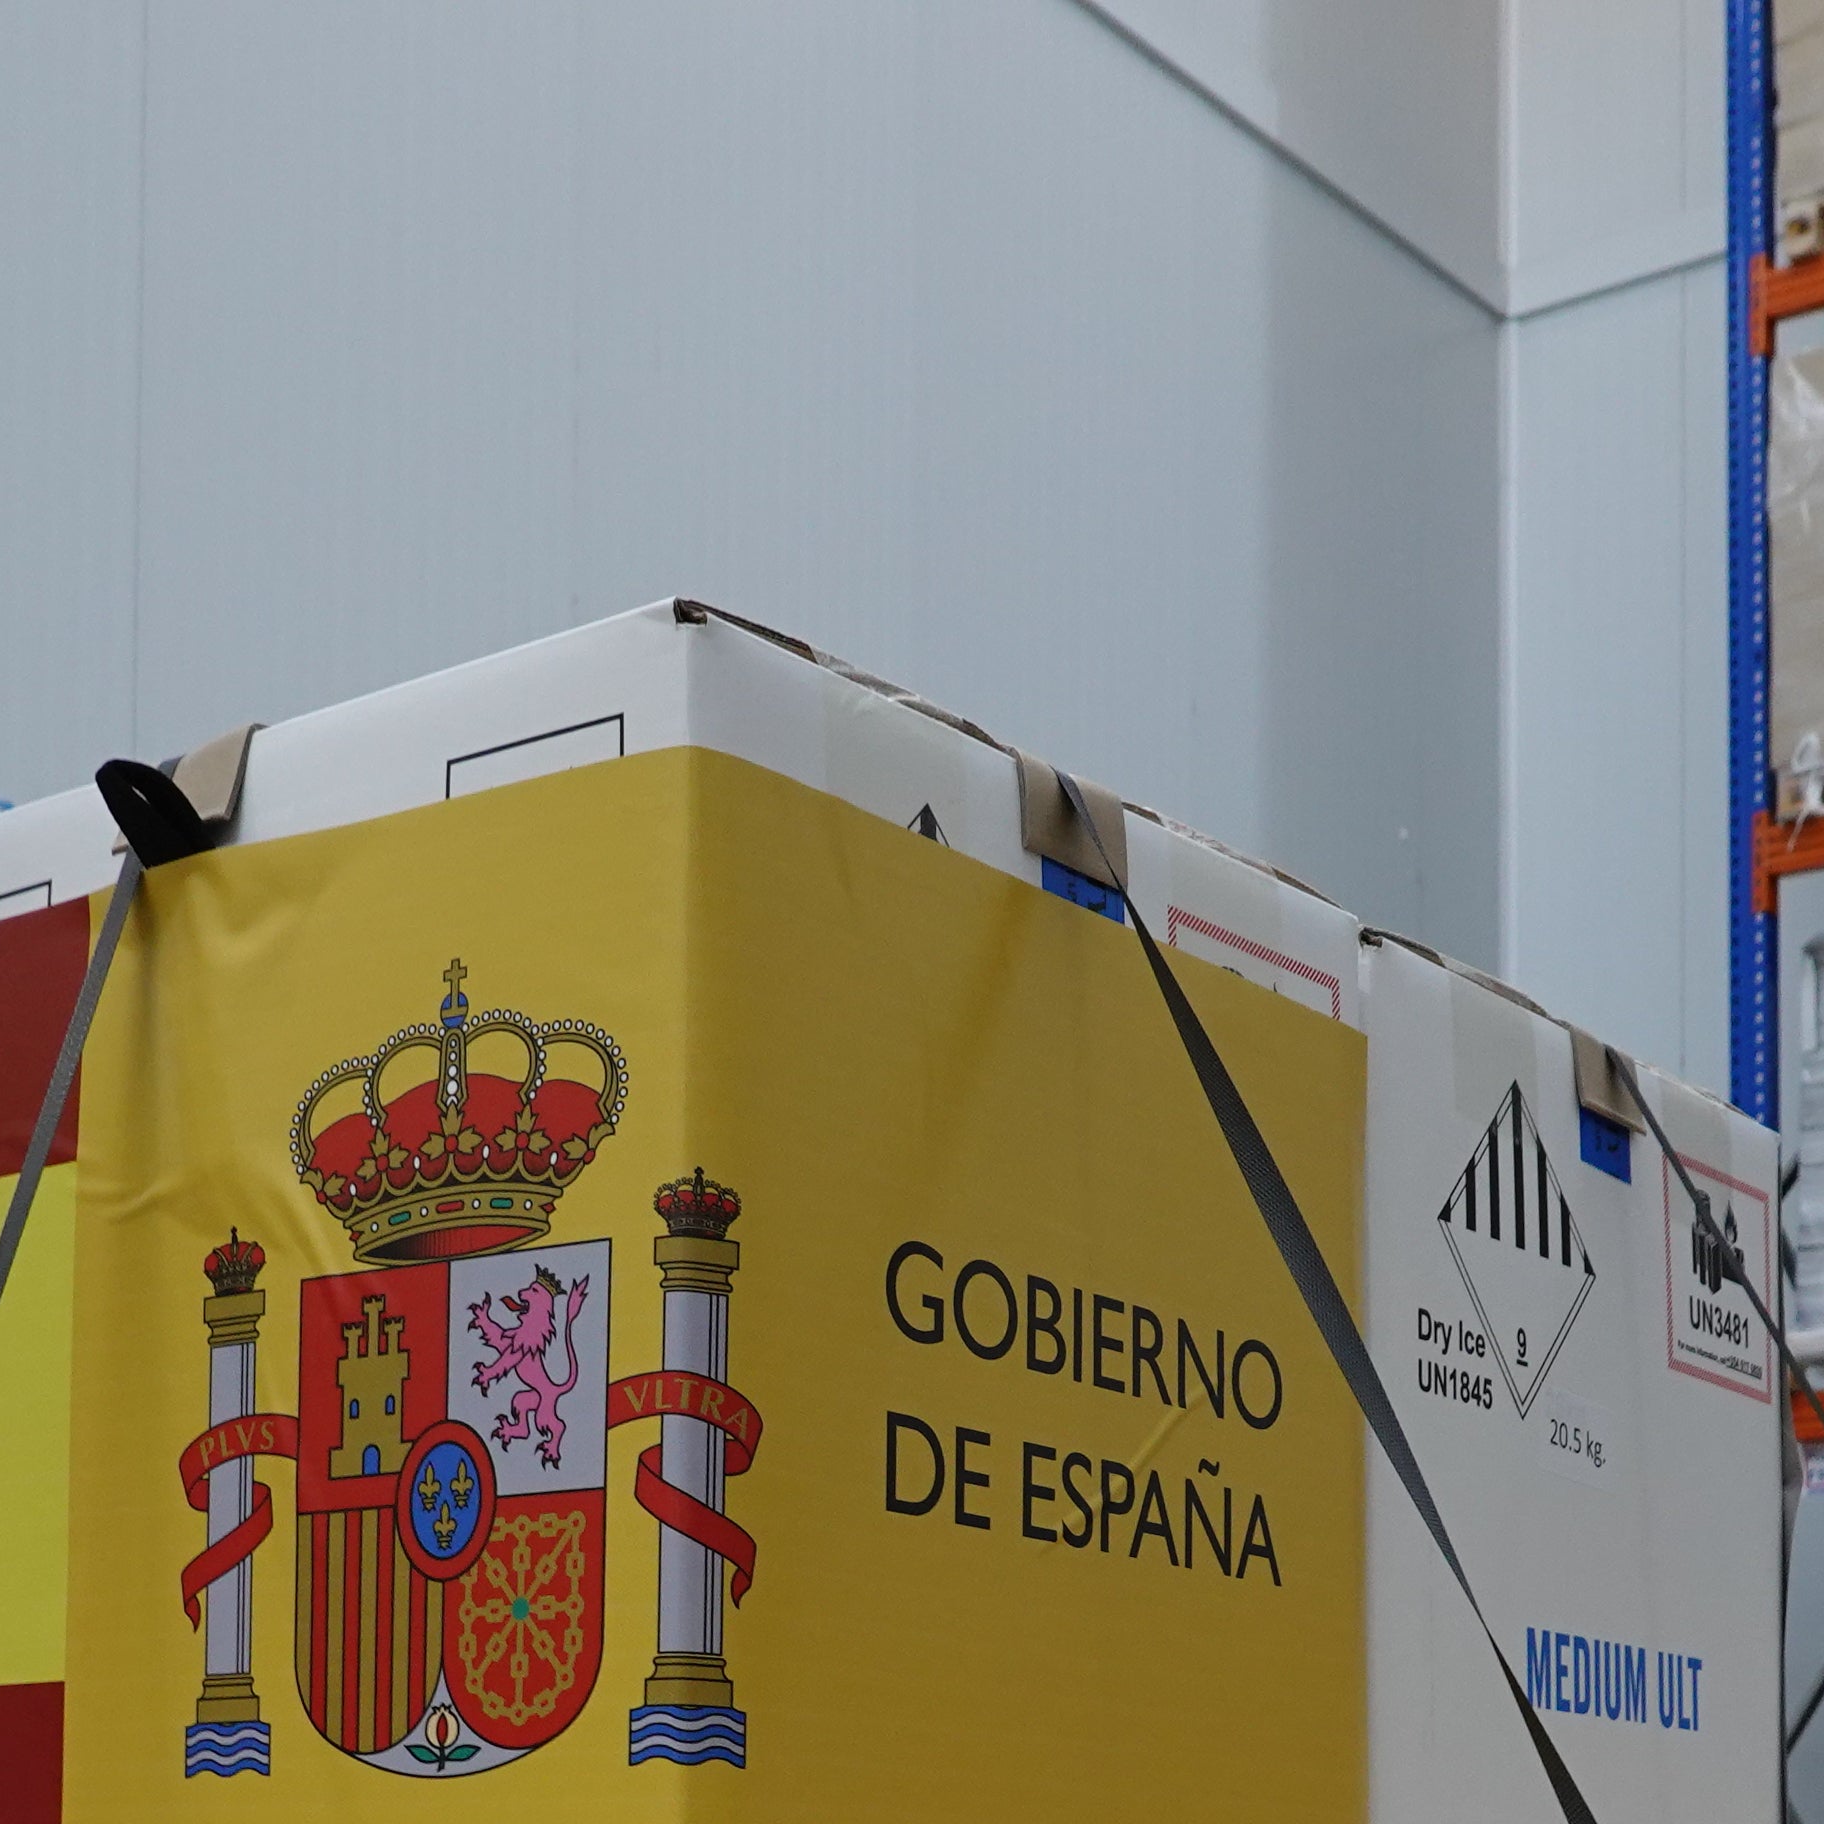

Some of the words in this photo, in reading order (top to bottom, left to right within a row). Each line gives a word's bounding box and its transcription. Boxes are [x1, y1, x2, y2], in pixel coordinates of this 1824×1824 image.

[886, 1241, 1283, 1430] GOBIERNO
[1418, 1308, 1452, 1355] Dry
[1459, 1320, 1486, 1358] Ice
[1517, 1327, 1527, 1358] 9
[1689, 1295, 1750, 1349] UN3481
[623, 1379, 751, 1442] VLTRA
[1418, 1358, 1493, 1410] UN1845
[198, 1420, 277, 1470] PLVS
[1550, 1419, 1581, 1454] 20.5
[886, 1410, 991, 1531] DE
[1022, 1441, 1282, 1587] ESPAÑA
[1526, 1626, 1647, 1724] MEDIUM
[1658, 1651, 1703, 1731] ULT
